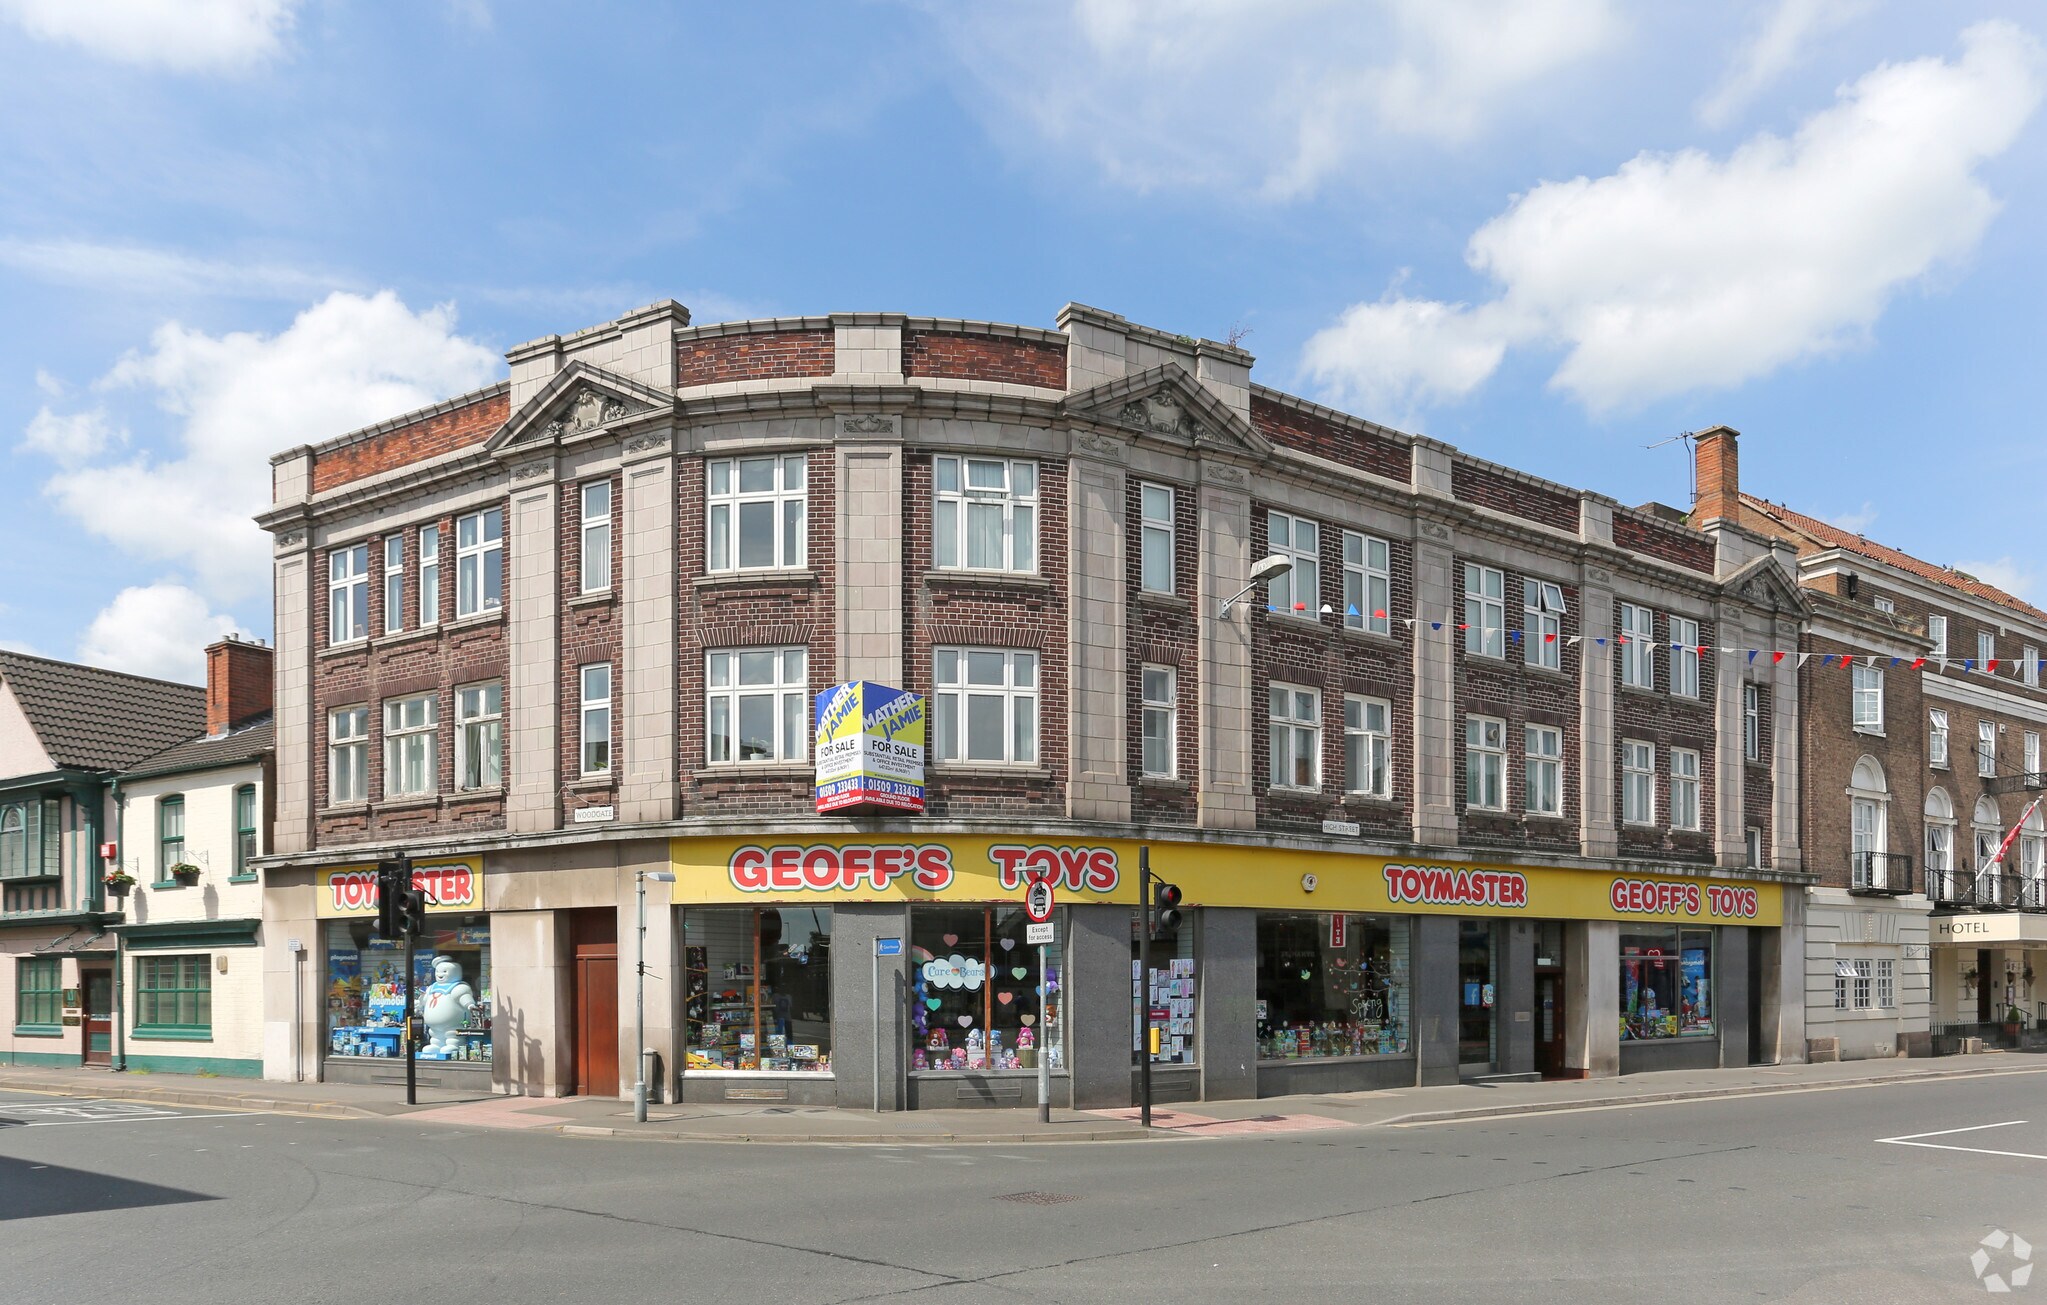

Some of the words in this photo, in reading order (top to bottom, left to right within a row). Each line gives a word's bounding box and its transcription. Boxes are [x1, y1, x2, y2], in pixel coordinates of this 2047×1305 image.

[816, 683, 851, 740] MATHER
[826, 692, 859, 744] JAMIE
[863, 692, 916, 732] MATHER
[882, 705, 922, 742] JAMIE
[821, 747, 833, 758] FOR
[836, 740, 854, 753] SALE
[872, 740, 891, 753] FOR
[895, 744, 917, 758] SALE
[820, 785, 835, 798] 01509
[838, 778, 858, 793] 233433
[868, 779, 891, 791] 01509
[894, 784, 919, 798] 233433
[576, 810, 612, 818] WOODGATE
[731, 846, 951, 889] GEOFF'S
[990, 848, 1117, 890] TOYS
[331, 867, 472, 907] TOYSTER
[1384, 866, 1526, 905] TOYMASTER
[1611, 880, 1700, 914] GEOFF'S
[1707, 886, 1758, 917] TOYS
[1032, 926, 1048, 934] Except
[1939, 922, 1989, 934] HOTEL
[928, 966, 950, 977] Care
[960, 966, 984, 978] Bears
[369, 995, 406, 1008] playmobil
[1350, 998, 1383, 1018] Spring
